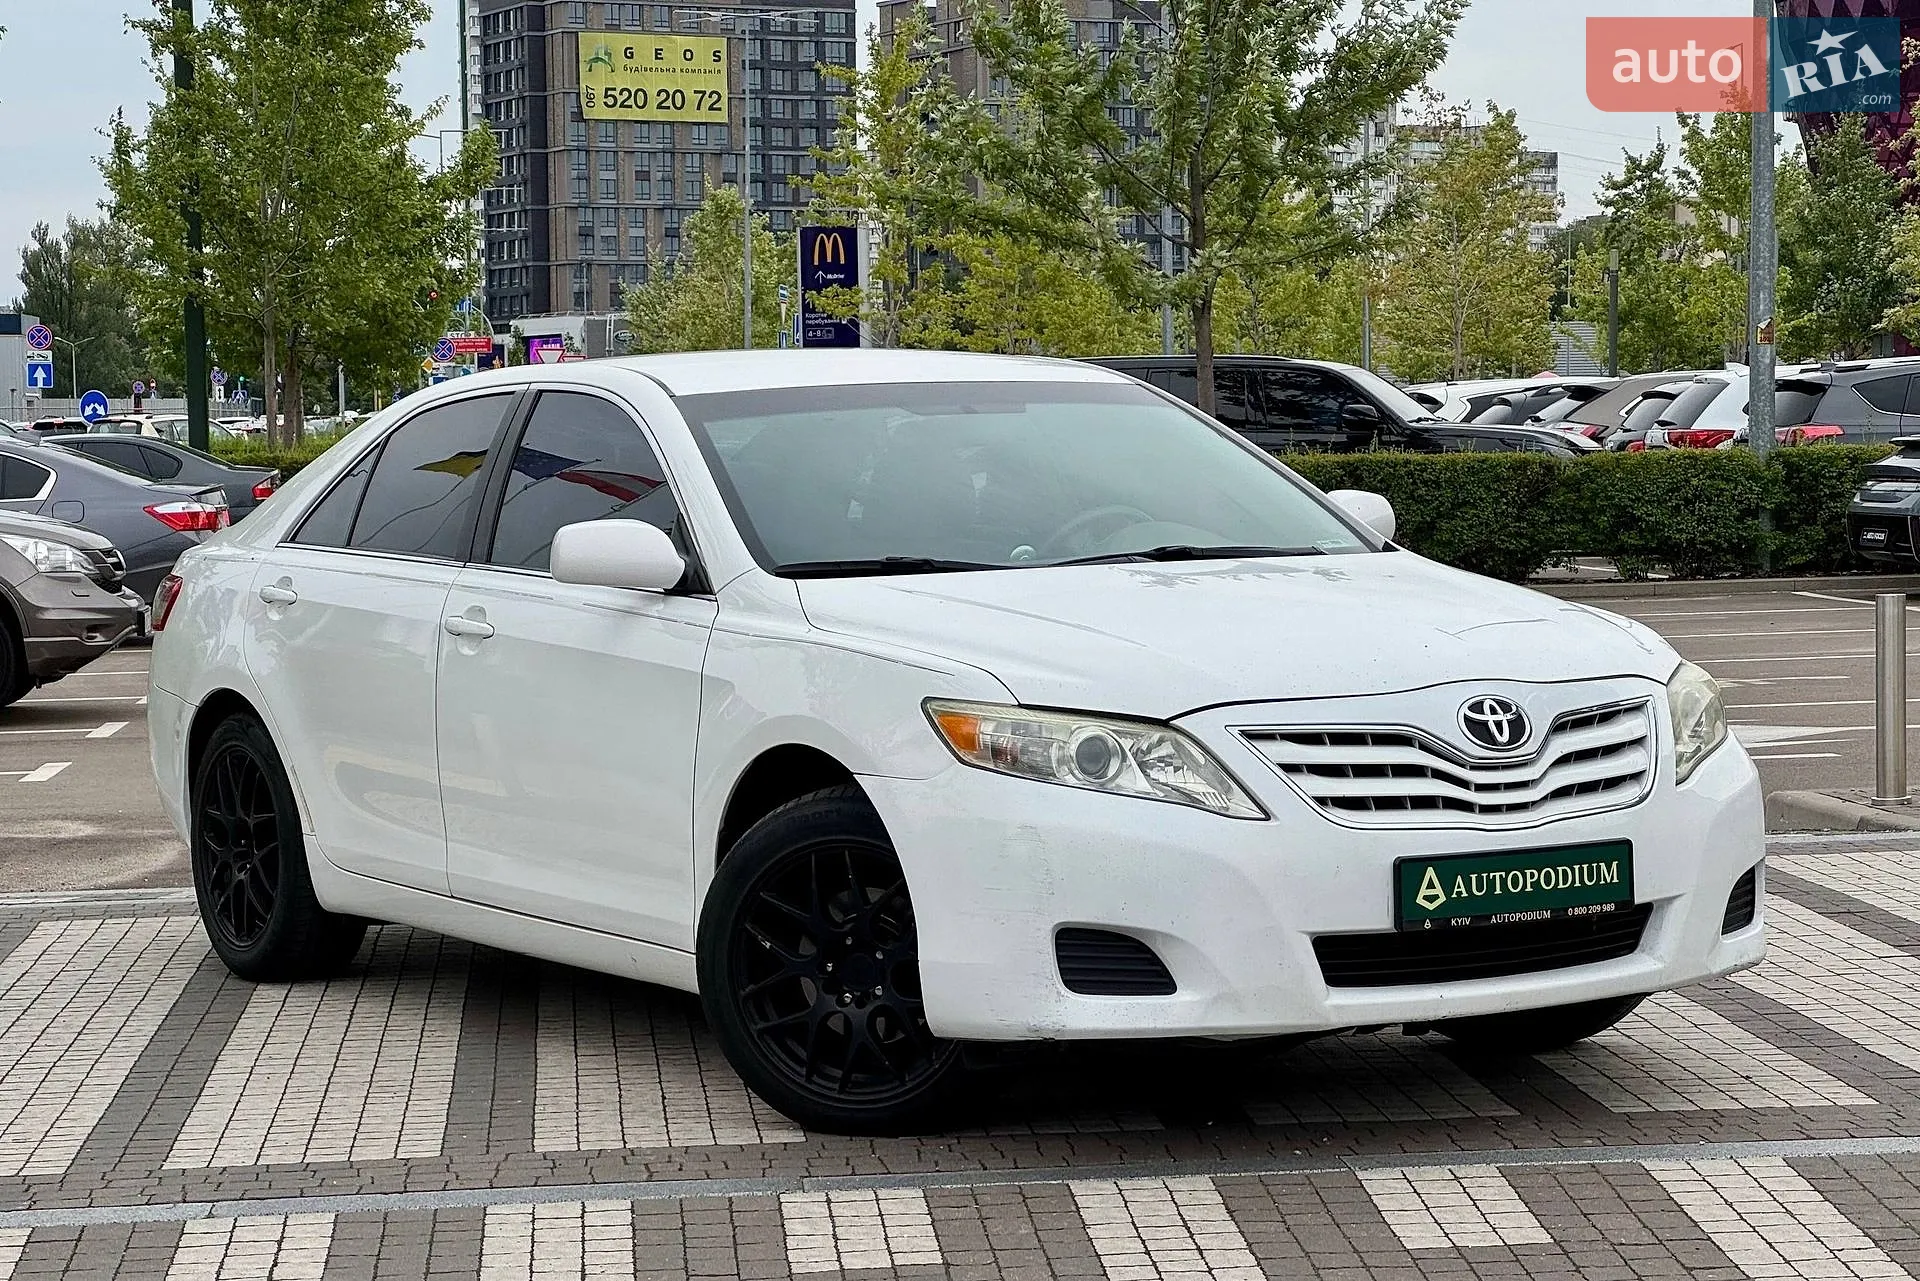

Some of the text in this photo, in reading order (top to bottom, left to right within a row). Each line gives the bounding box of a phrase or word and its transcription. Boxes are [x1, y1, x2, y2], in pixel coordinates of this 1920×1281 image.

[624, 47, 722, 62] GEOS
[623, 64, 722, 75] будівельна компанія
[585, 85, 722, 111] 067 520 20 72
[1451, 861, 1619, 898] AUTOPODIUM
[1451, 903, 1616, 927] KYIV AUTOPODIUM 0 800 209 989
